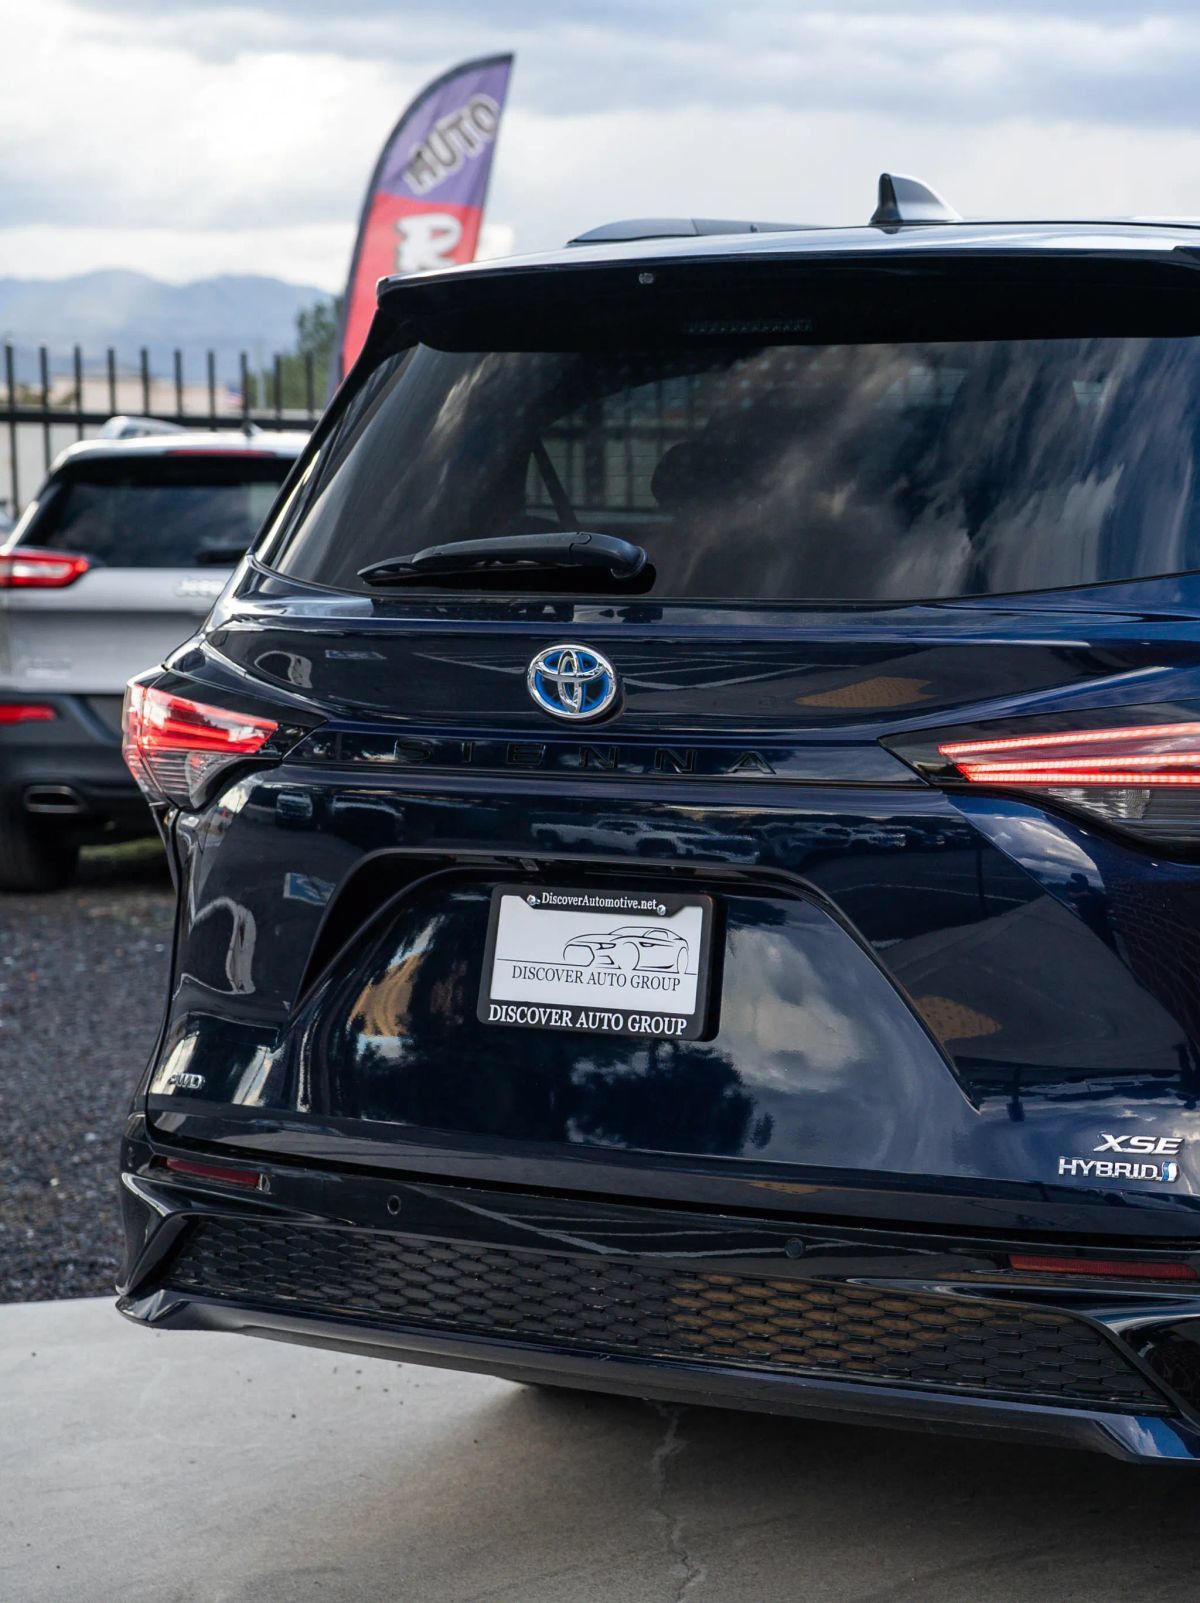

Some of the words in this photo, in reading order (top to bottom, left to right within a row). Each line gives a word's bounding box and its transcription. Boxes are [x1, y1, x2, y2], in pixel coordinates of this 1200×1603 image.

[405, 97, 498, 190] AUTO
[394, 735, 777, 777] SIENNA
[541, 892, 657, 911] DiscoverAutomotive.net
[511, 965, 583, 985] DISCOVER
[587, 972, 627, 988] AUTO
[630, 975, 681, 992] GROUP
[488, 1004, 573, 1028] DISCOVER
[576, 1011, 624, 1032] AUTO
[628, 1015, 687, 1036] GROUP
[1093, 1133, 1184, 1155] XSE
[1058, 1157, 1159, 1179] HYBRID
